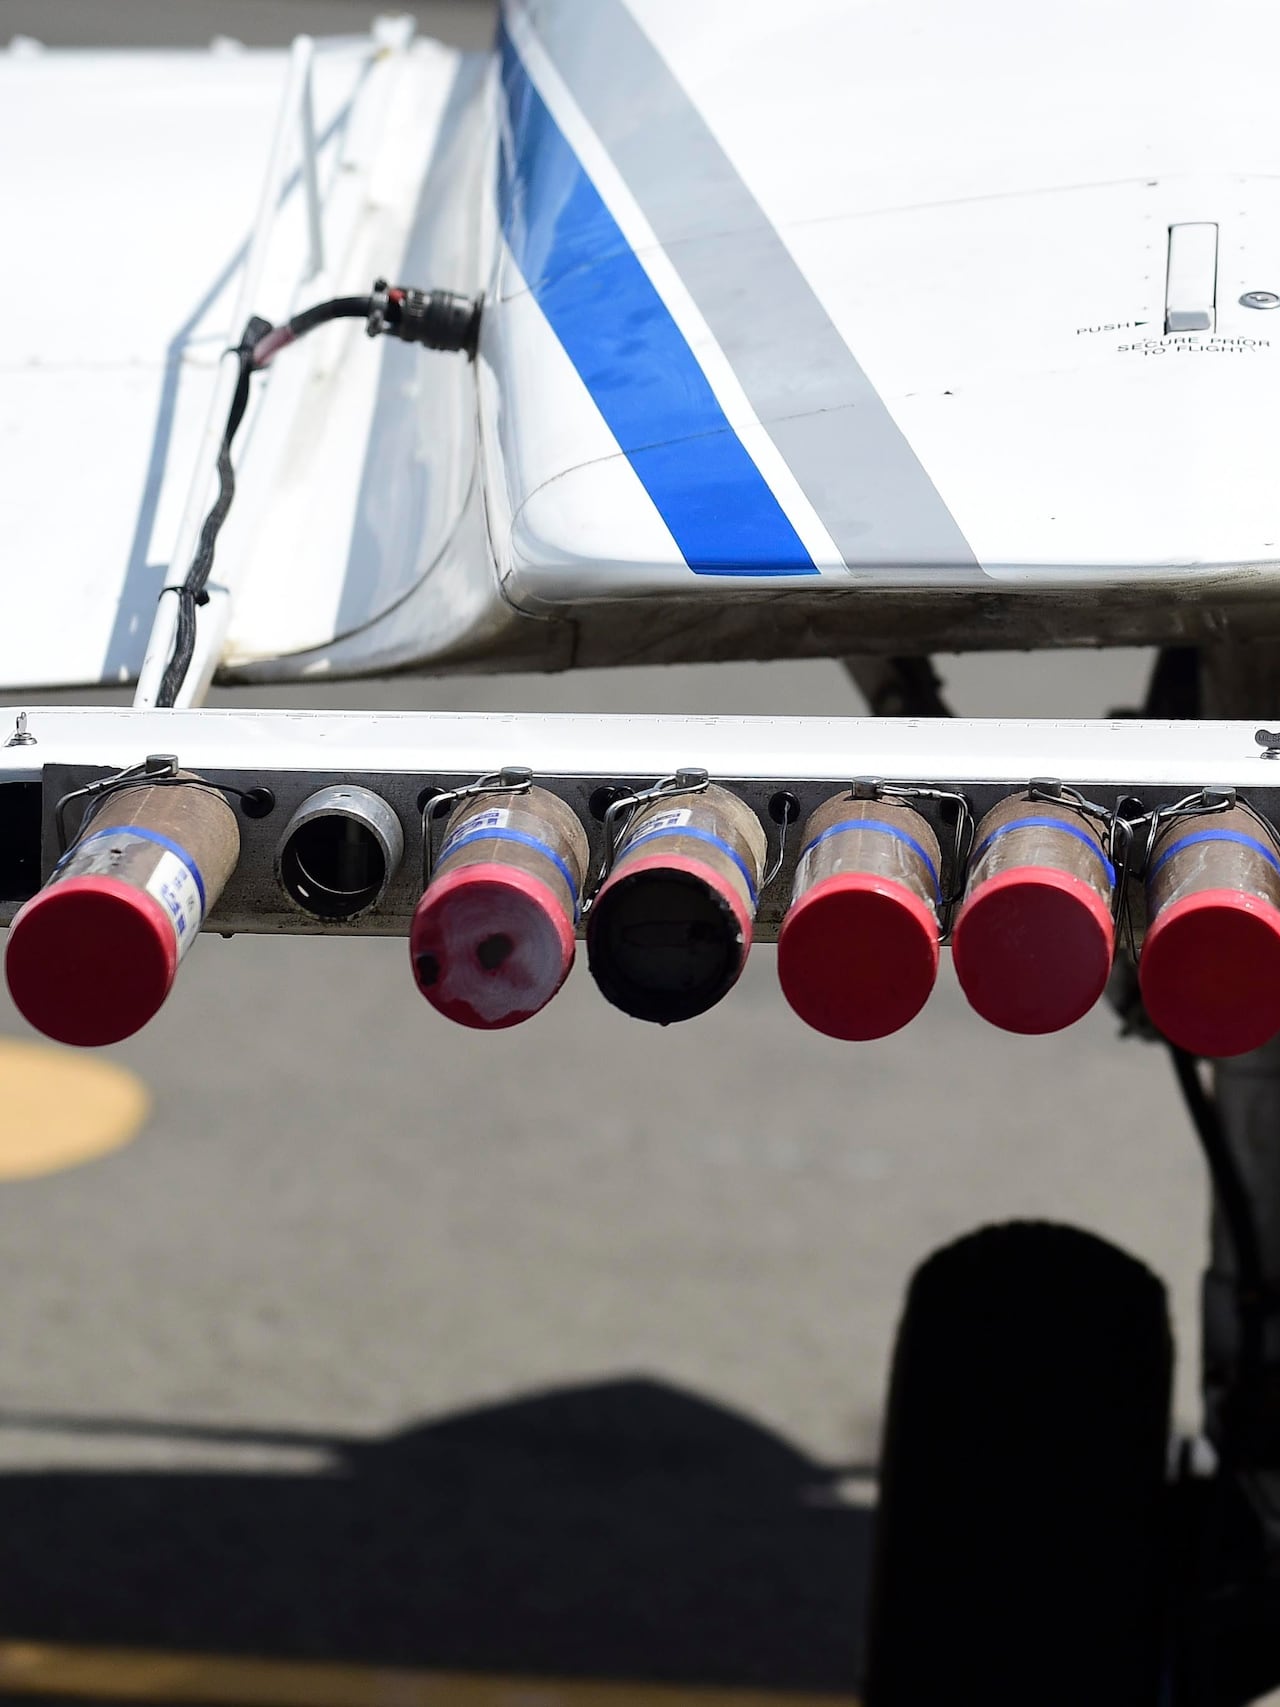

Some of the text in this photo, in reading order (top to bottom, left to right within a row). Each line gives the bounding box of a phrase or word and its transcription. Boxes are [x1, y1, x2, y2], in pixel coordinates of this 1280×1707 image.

[1076, 321, 1130, 335] PUSH
[1117, 336, 1271, 352] SECURE PRIOR
[1141, 345, 1245, 356] TO FLIGHT
